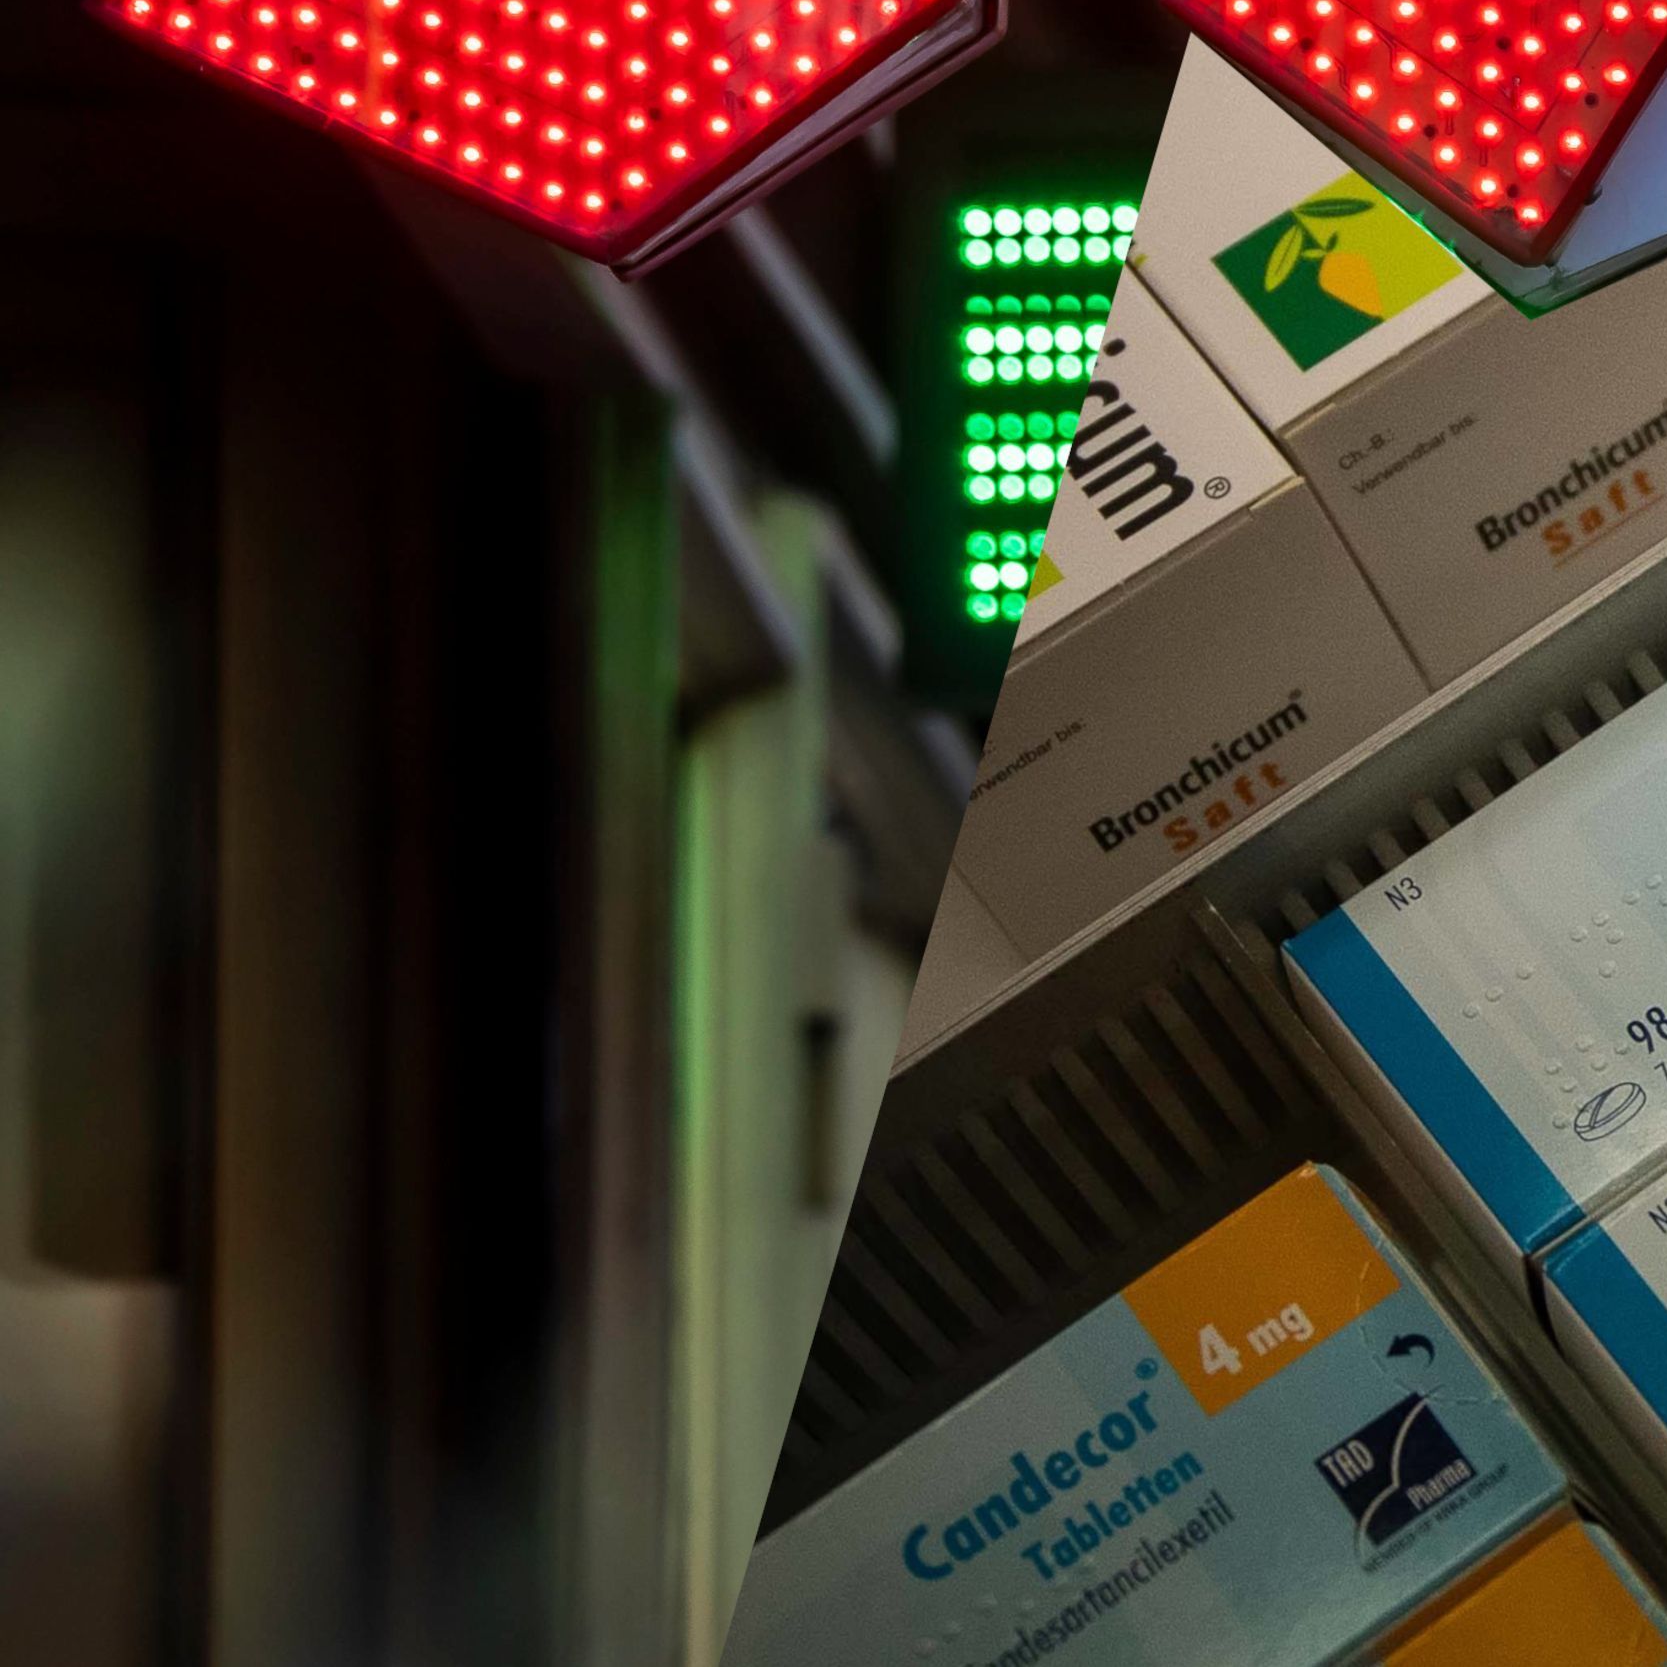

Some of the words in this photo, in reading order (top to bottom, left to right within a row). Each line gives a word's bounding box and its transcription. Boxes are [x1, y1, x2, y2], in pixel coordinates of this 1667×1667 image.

[1542, 469, 1656, 555] Saft
[1162, 761, 1288, 854] Saft
[1383, 875, 1424, 912] N3
[1197, 1322, 1242, 1376] 4
[1245, 1300, 1317, 1359] mg
[1320, 1439, 1376, 1488] TAD
[1405, 1458, 1473, 1512] Pharma
[1019, 1450, 1204, 1581] Tabletten
